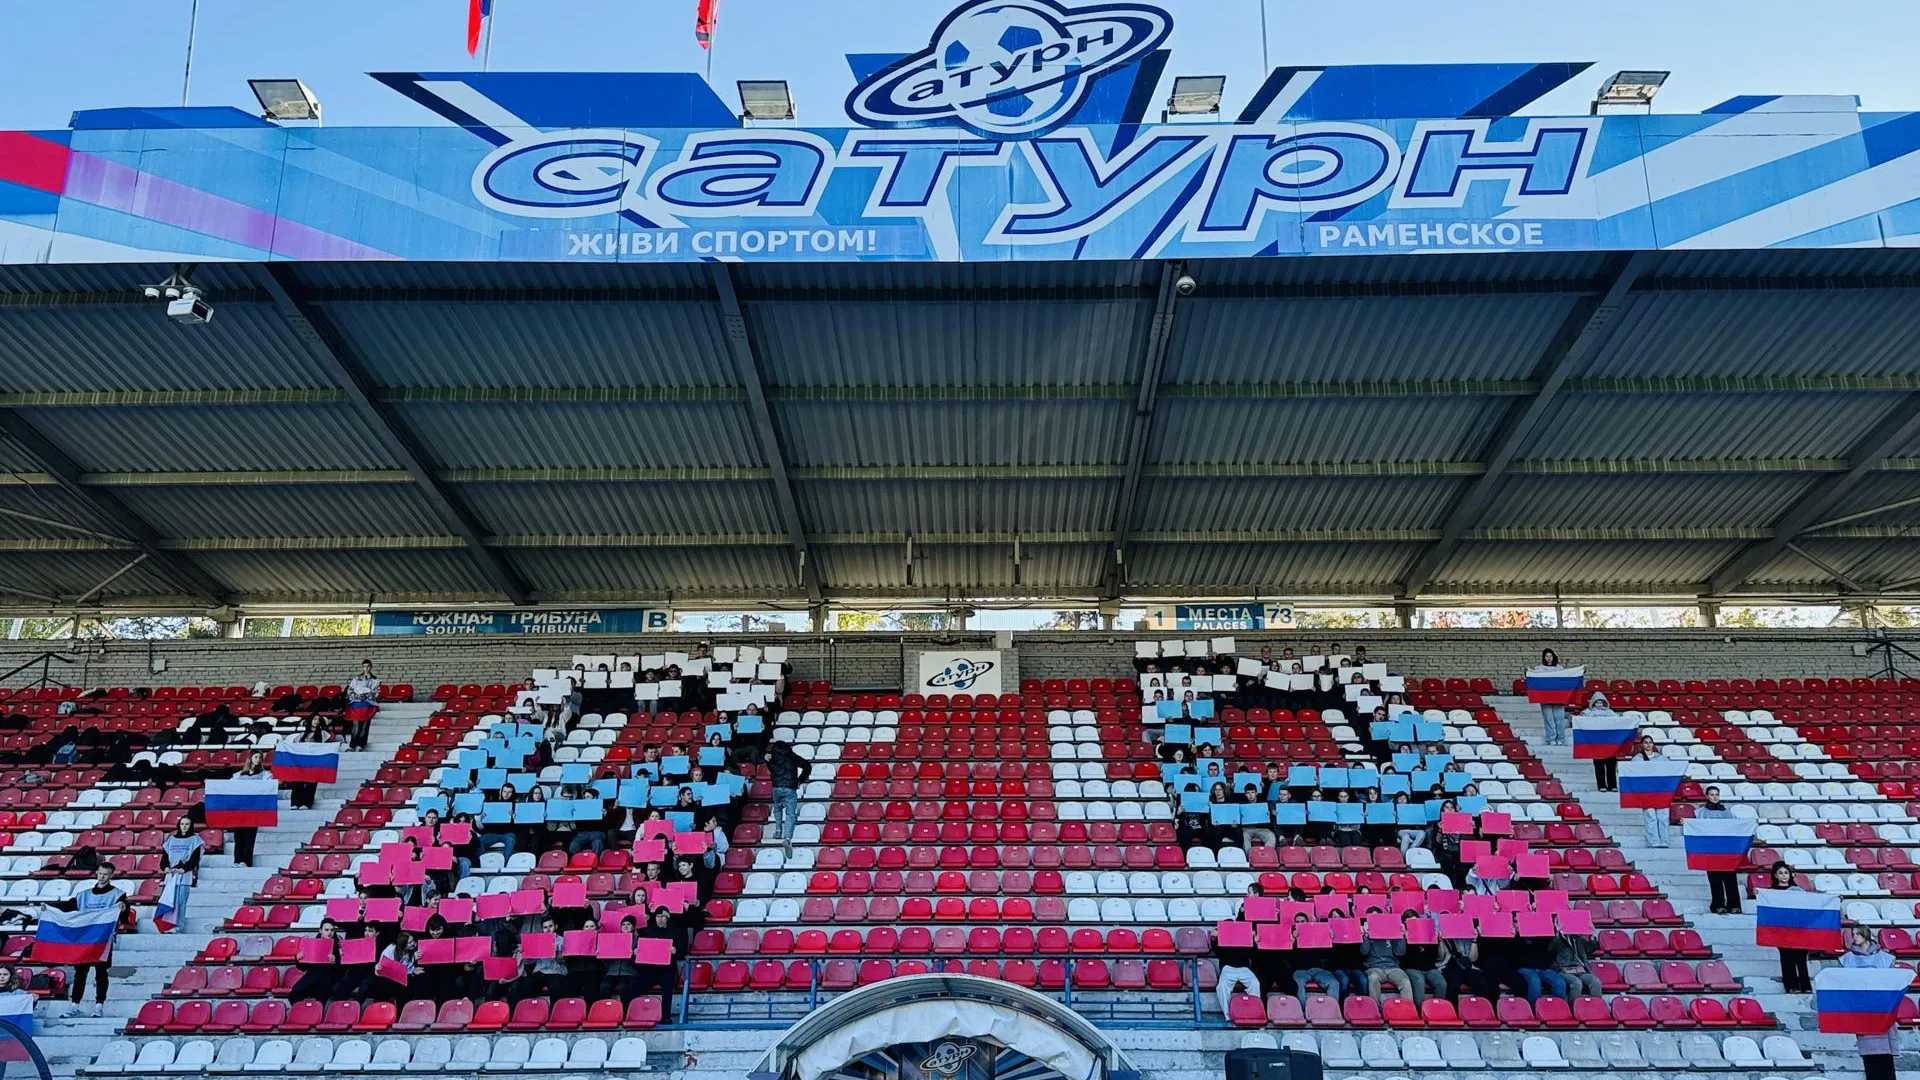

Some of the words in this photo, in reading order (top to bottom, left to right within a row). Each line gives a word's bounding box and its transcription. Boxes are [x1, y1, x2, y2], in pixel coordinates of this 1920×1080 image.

[1318, 222, 1544, 249] РАМЕНСКОЕ
[567, 233, 679, 257] ЖИВИ
[691, 229, 877, 255] СПОРТОМ!
[412, 611, 494, 625] ЮЖНАЯ
[509, 611, 602, 624] ТРИБУНА
[1154, 611, 1163, 627] 1
[1188, 607, 1250, 621] МЕСТА
[1266, 608, 1293, 624] 73
[425, 625, 476, 635] SOUTH
[522, 624, 588, 634] TRIBUNE
[1193, 621, 1247, 631] PALACES
